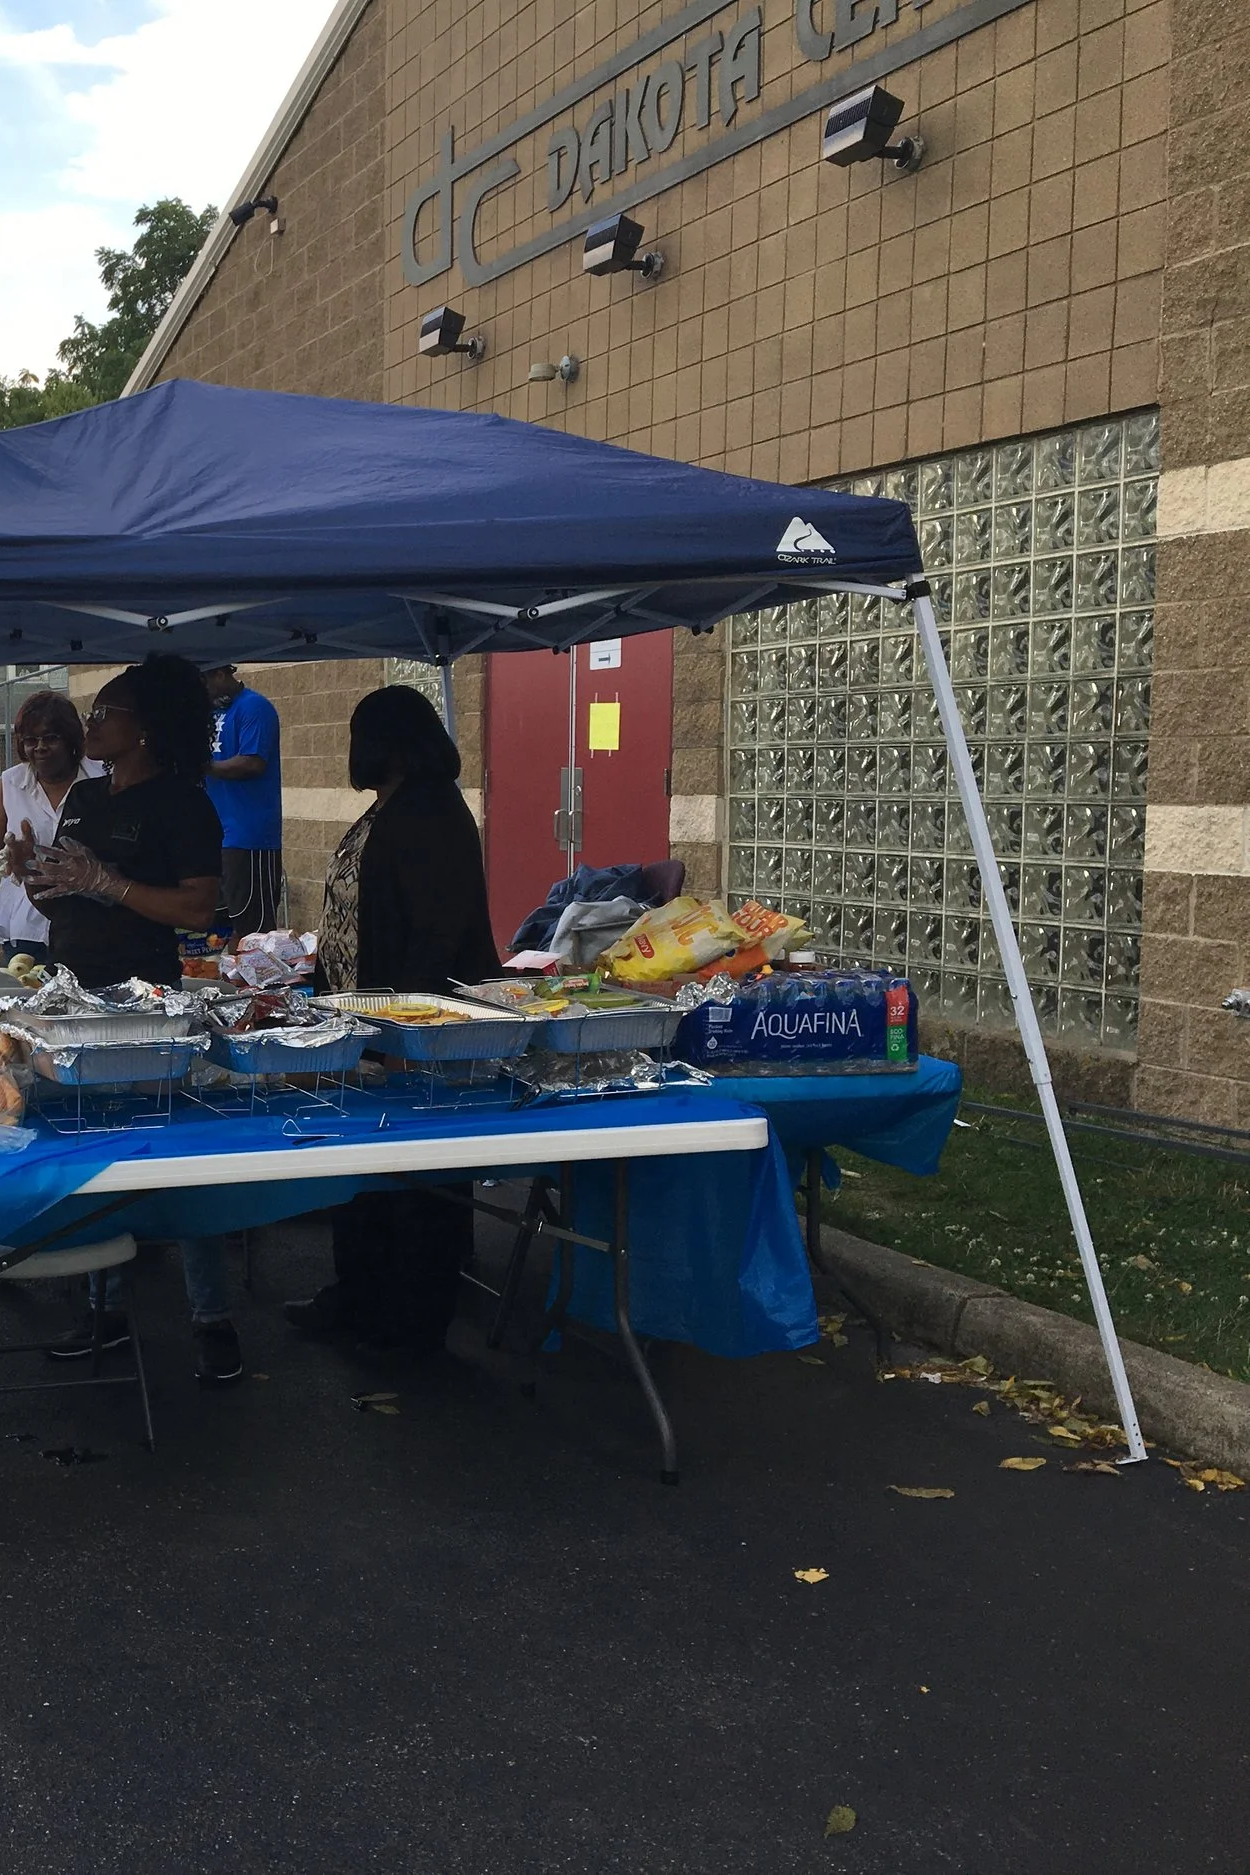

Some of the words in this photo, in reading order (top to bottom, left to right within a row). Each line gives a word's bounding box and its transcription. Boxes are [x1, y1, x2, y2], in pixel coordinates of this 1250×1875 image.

[548, 7, 763, 212] DAKOTA
[777, 553, 810, 564] OZARK
[811, 556, 836, 565] TRAIL
[890, 1005, 905, 1016] 32
[751, 1009, 862, 1040] AQUAFINA
